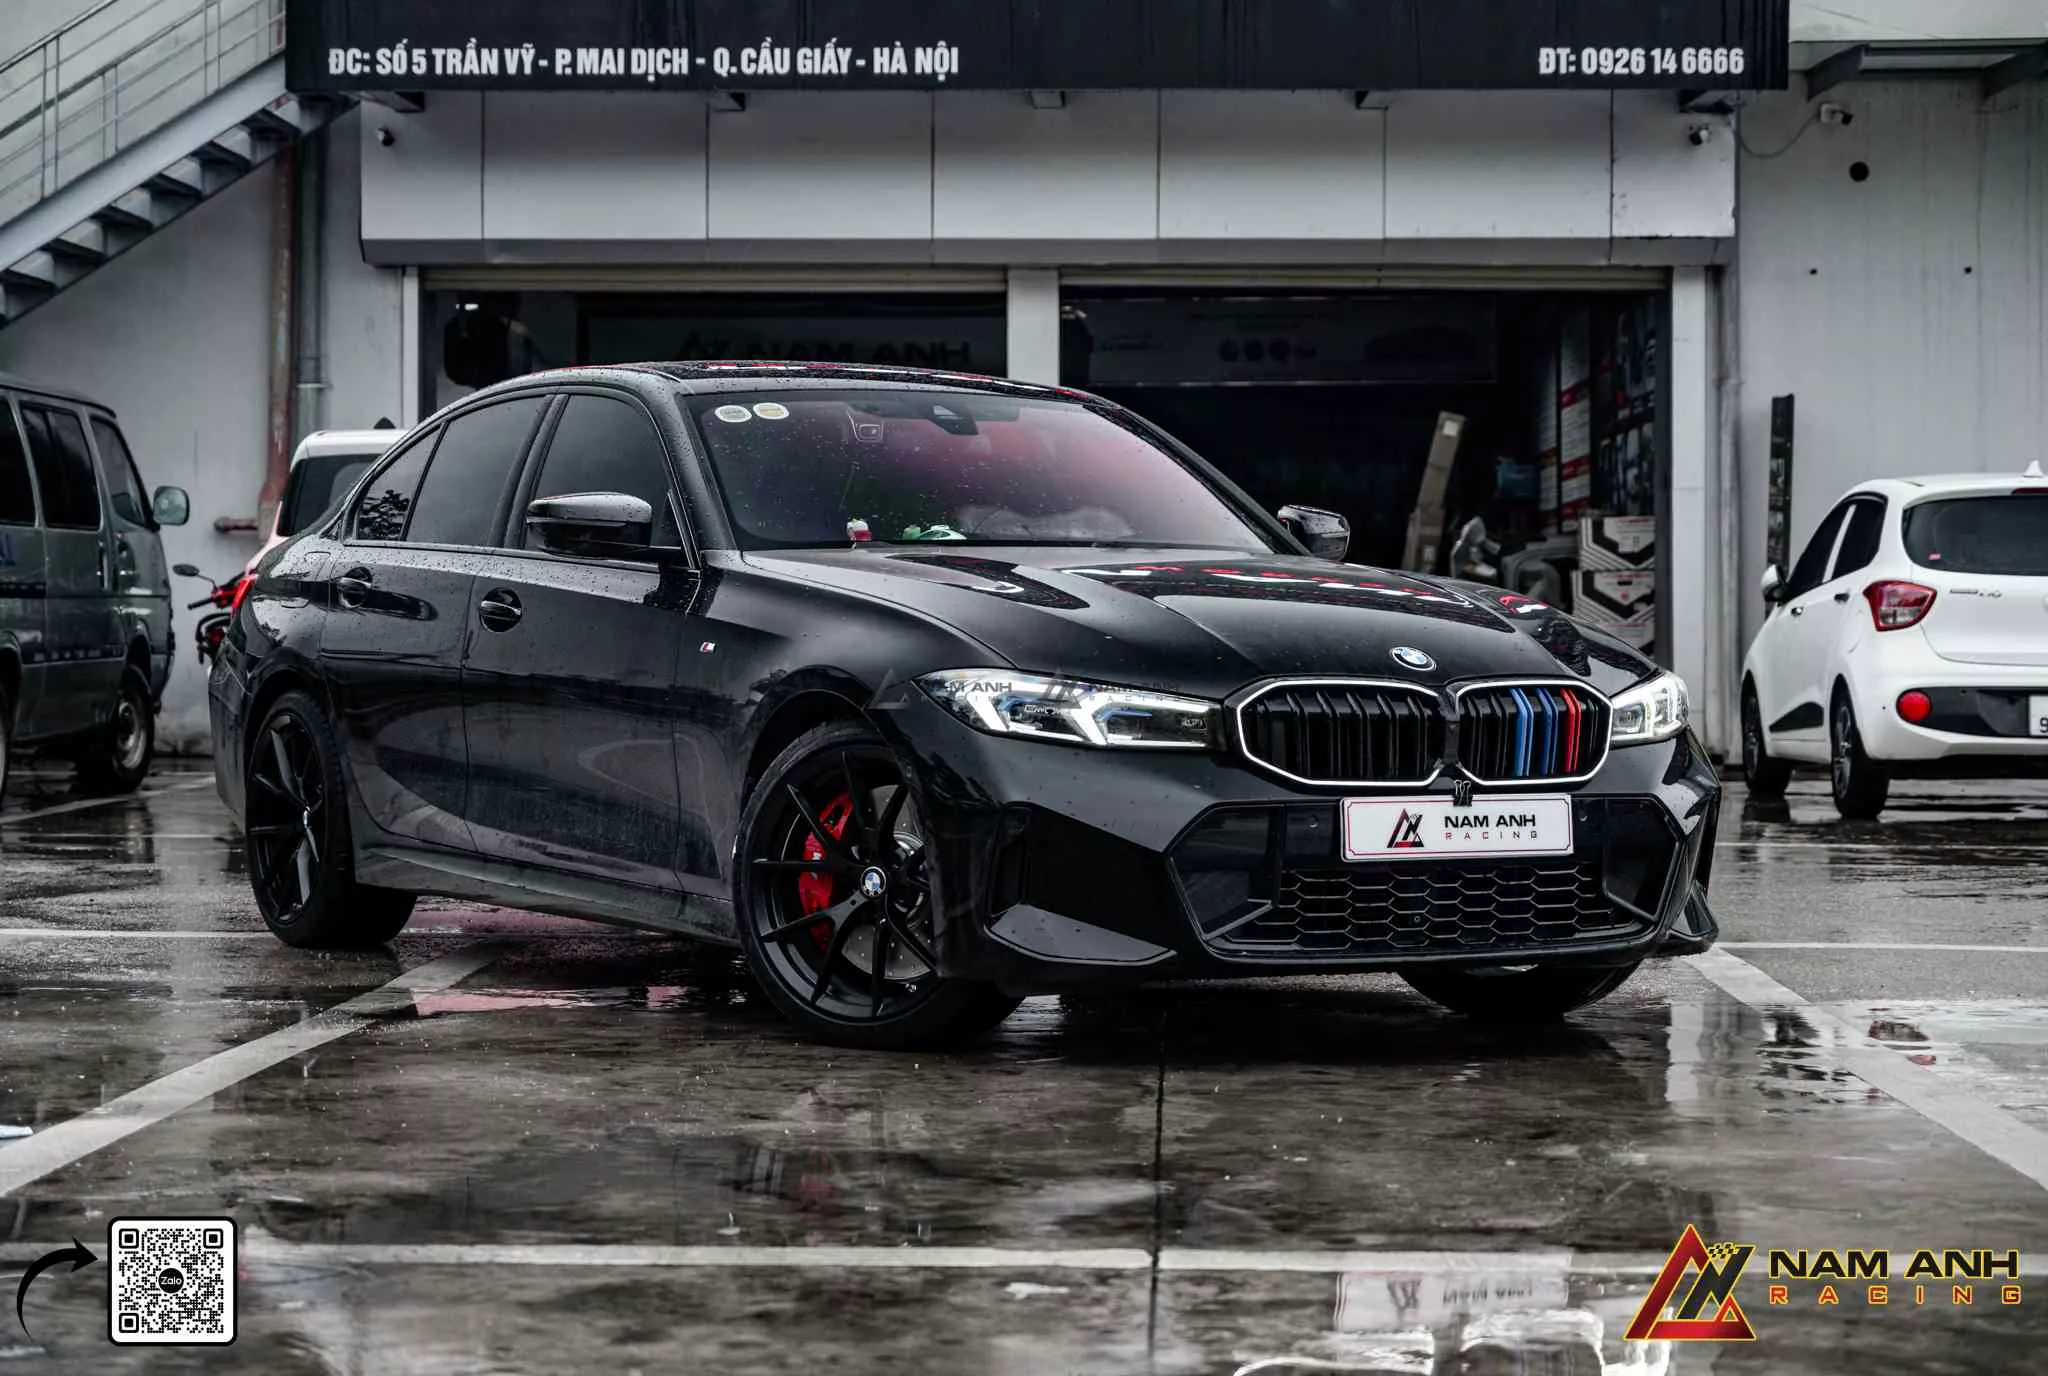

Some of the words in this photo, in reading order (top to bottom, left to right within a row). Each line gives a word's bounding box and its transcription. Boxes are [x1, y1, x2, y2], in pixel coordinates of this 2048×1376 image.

[327, 48, 371, 75] ĐC:
[375, 38, 409, 75] SỐ
[411, 48, 428, 75] 5
[431, 37, 499, 75] TRẦN
[503, 42, 536, 75] VỸ
[630, 47, 689, 82] DỊCH
[796, 37, 853, 75] GIẤY
[872, 40, 908, 75] HÀ
[914, 40, 960, 82] NỘI
[1538, 47, 1577, 75] ĐT:
[1581, 47, 1647, 75] 0926
[1650, 47, 1679, 75] 14
[1681, 47, 1745, 75] 6666
[1444, 815, 1489, 829] NAM
[1496, 814, 1537, 828] ANH
[1445, 831, 1538, 841] RACING
